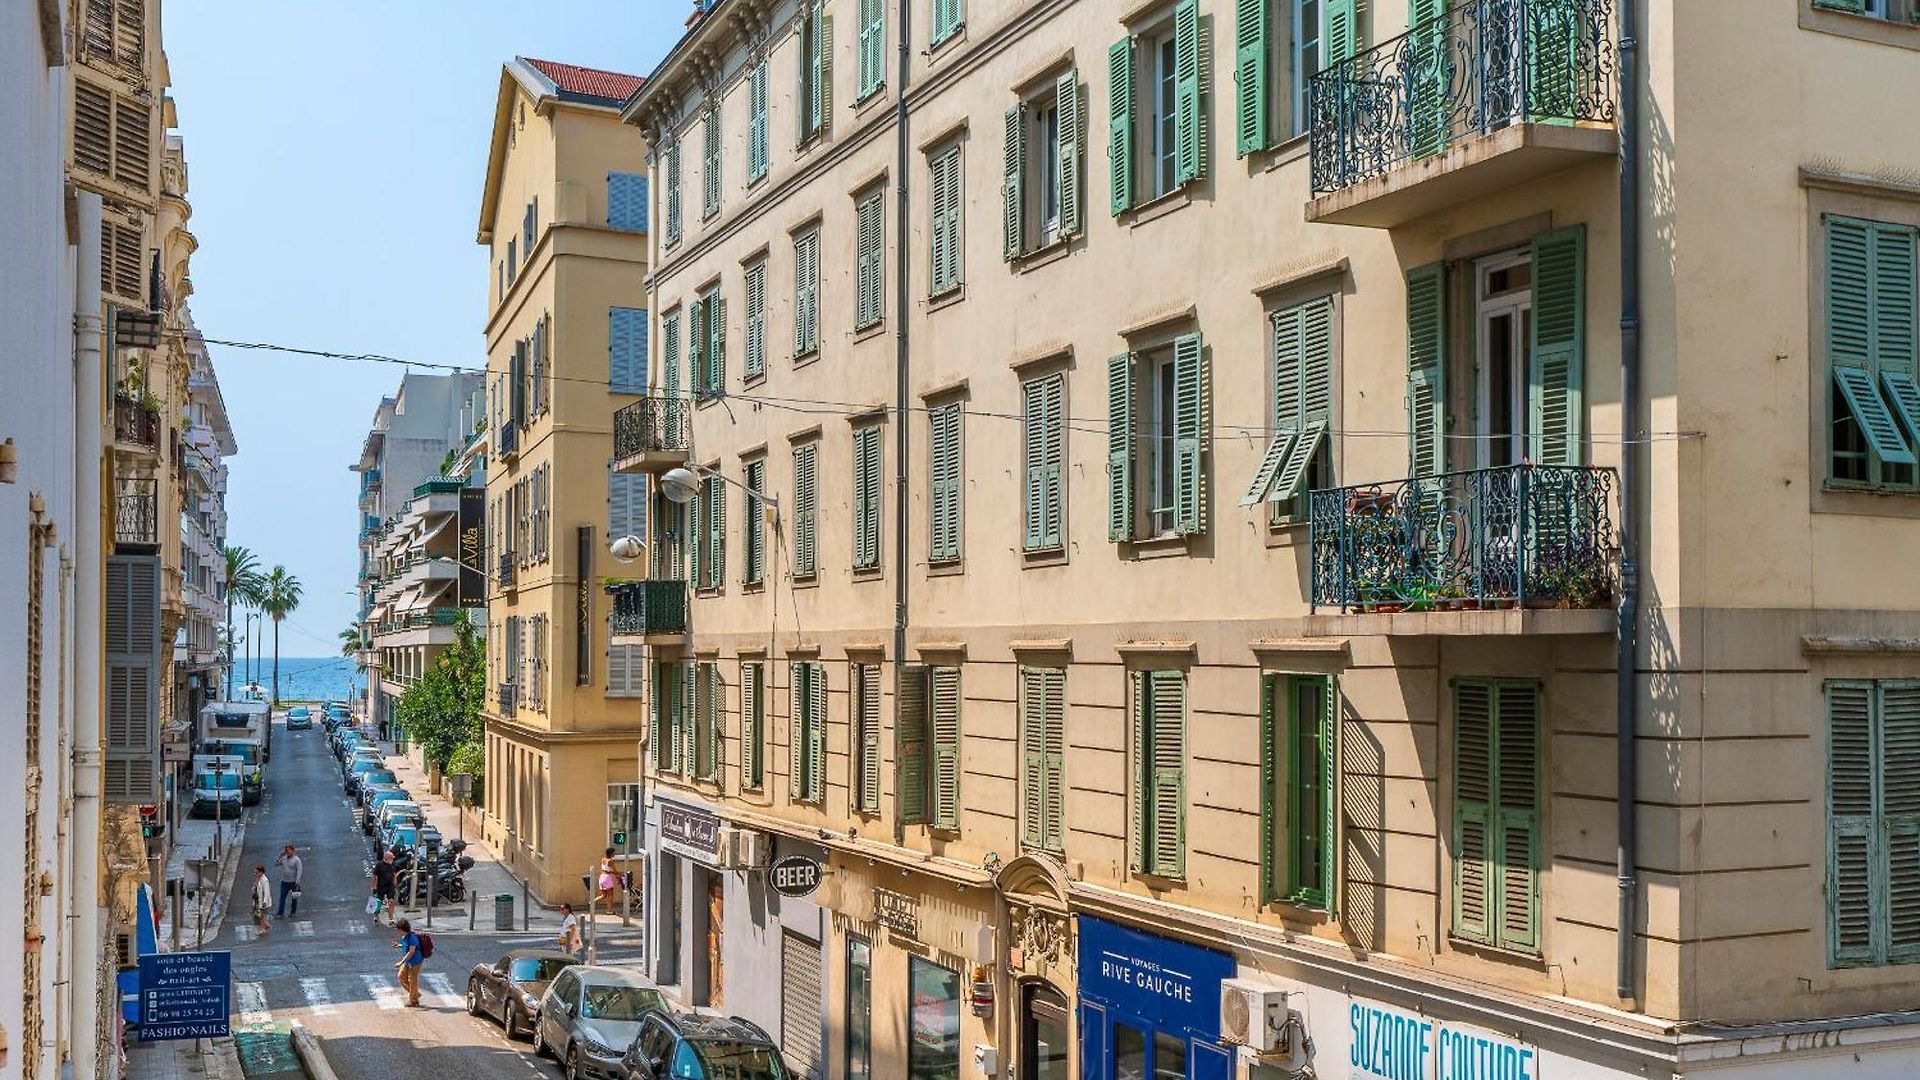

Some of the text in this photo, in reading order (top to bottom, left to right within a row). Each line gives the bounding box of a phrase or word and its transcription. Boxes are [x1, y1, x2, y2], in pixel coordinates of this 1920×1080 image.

[461, 526, 479, 561] Villa
[776, 865, 815, 887] BEER
[180, 965, 207, 974] ongles
[1131, 957, 1161, 972] VOYAGES
[1102, 961, 1192, 1003] RIVE GAUCHE
[142, 1025, 227, 1038] FASHIO'NAILS
[1350, 1003, 1432, 1080] SUZANNE
